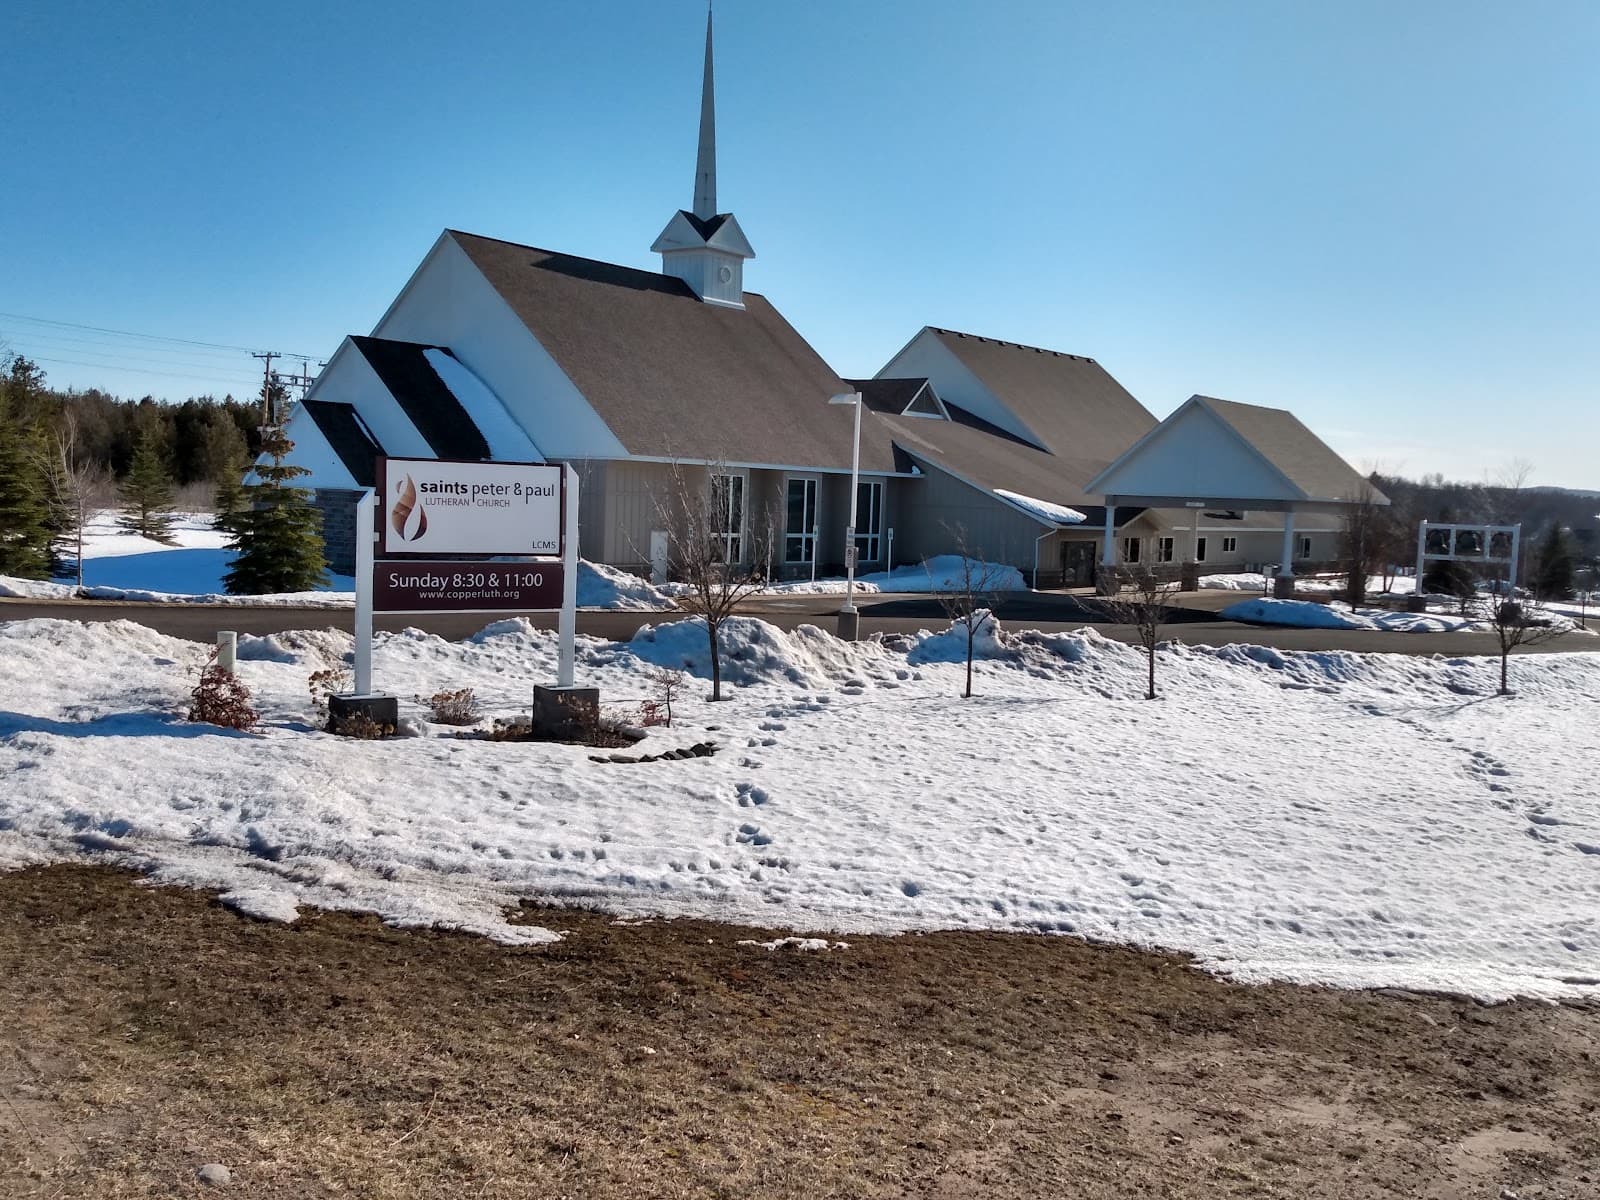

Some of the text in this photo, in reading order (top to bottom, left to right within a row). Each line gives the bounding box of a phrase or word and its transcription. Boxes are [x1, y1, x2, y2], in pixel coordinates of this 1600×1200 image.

[420, 480, 554, 504] saints peter & paul
[425, 497, 510, 508] LUTHERAN CHURCH
[532, 541, 556, 549] LCMS
[389, 573, 543, 590] Sunday 8:30 & 11:00
[419, 589, 520, 600] www.copperluth.org
